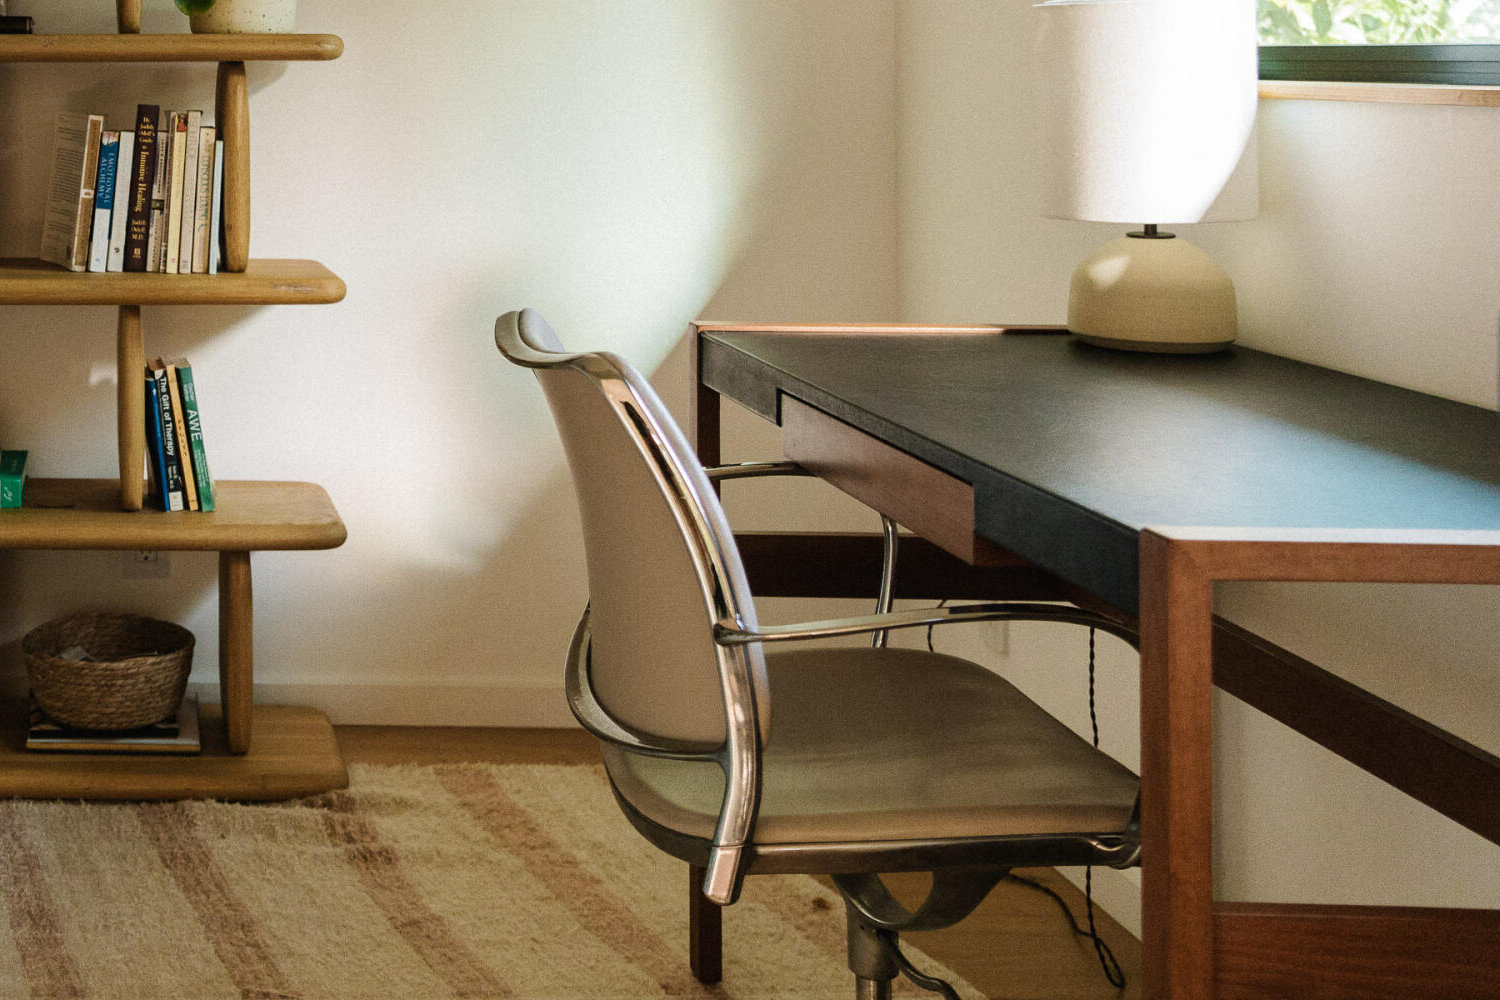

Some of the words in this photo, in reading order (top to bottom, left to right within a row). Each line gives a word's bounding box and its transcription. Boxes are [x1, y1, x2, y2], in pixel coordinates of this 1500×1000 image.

[134, 183, 147, 212] Healing
[164, 411, 170, 421] of
[187, 409, 202, 440] AWE
[165, 422, 175, 456] Therapy
